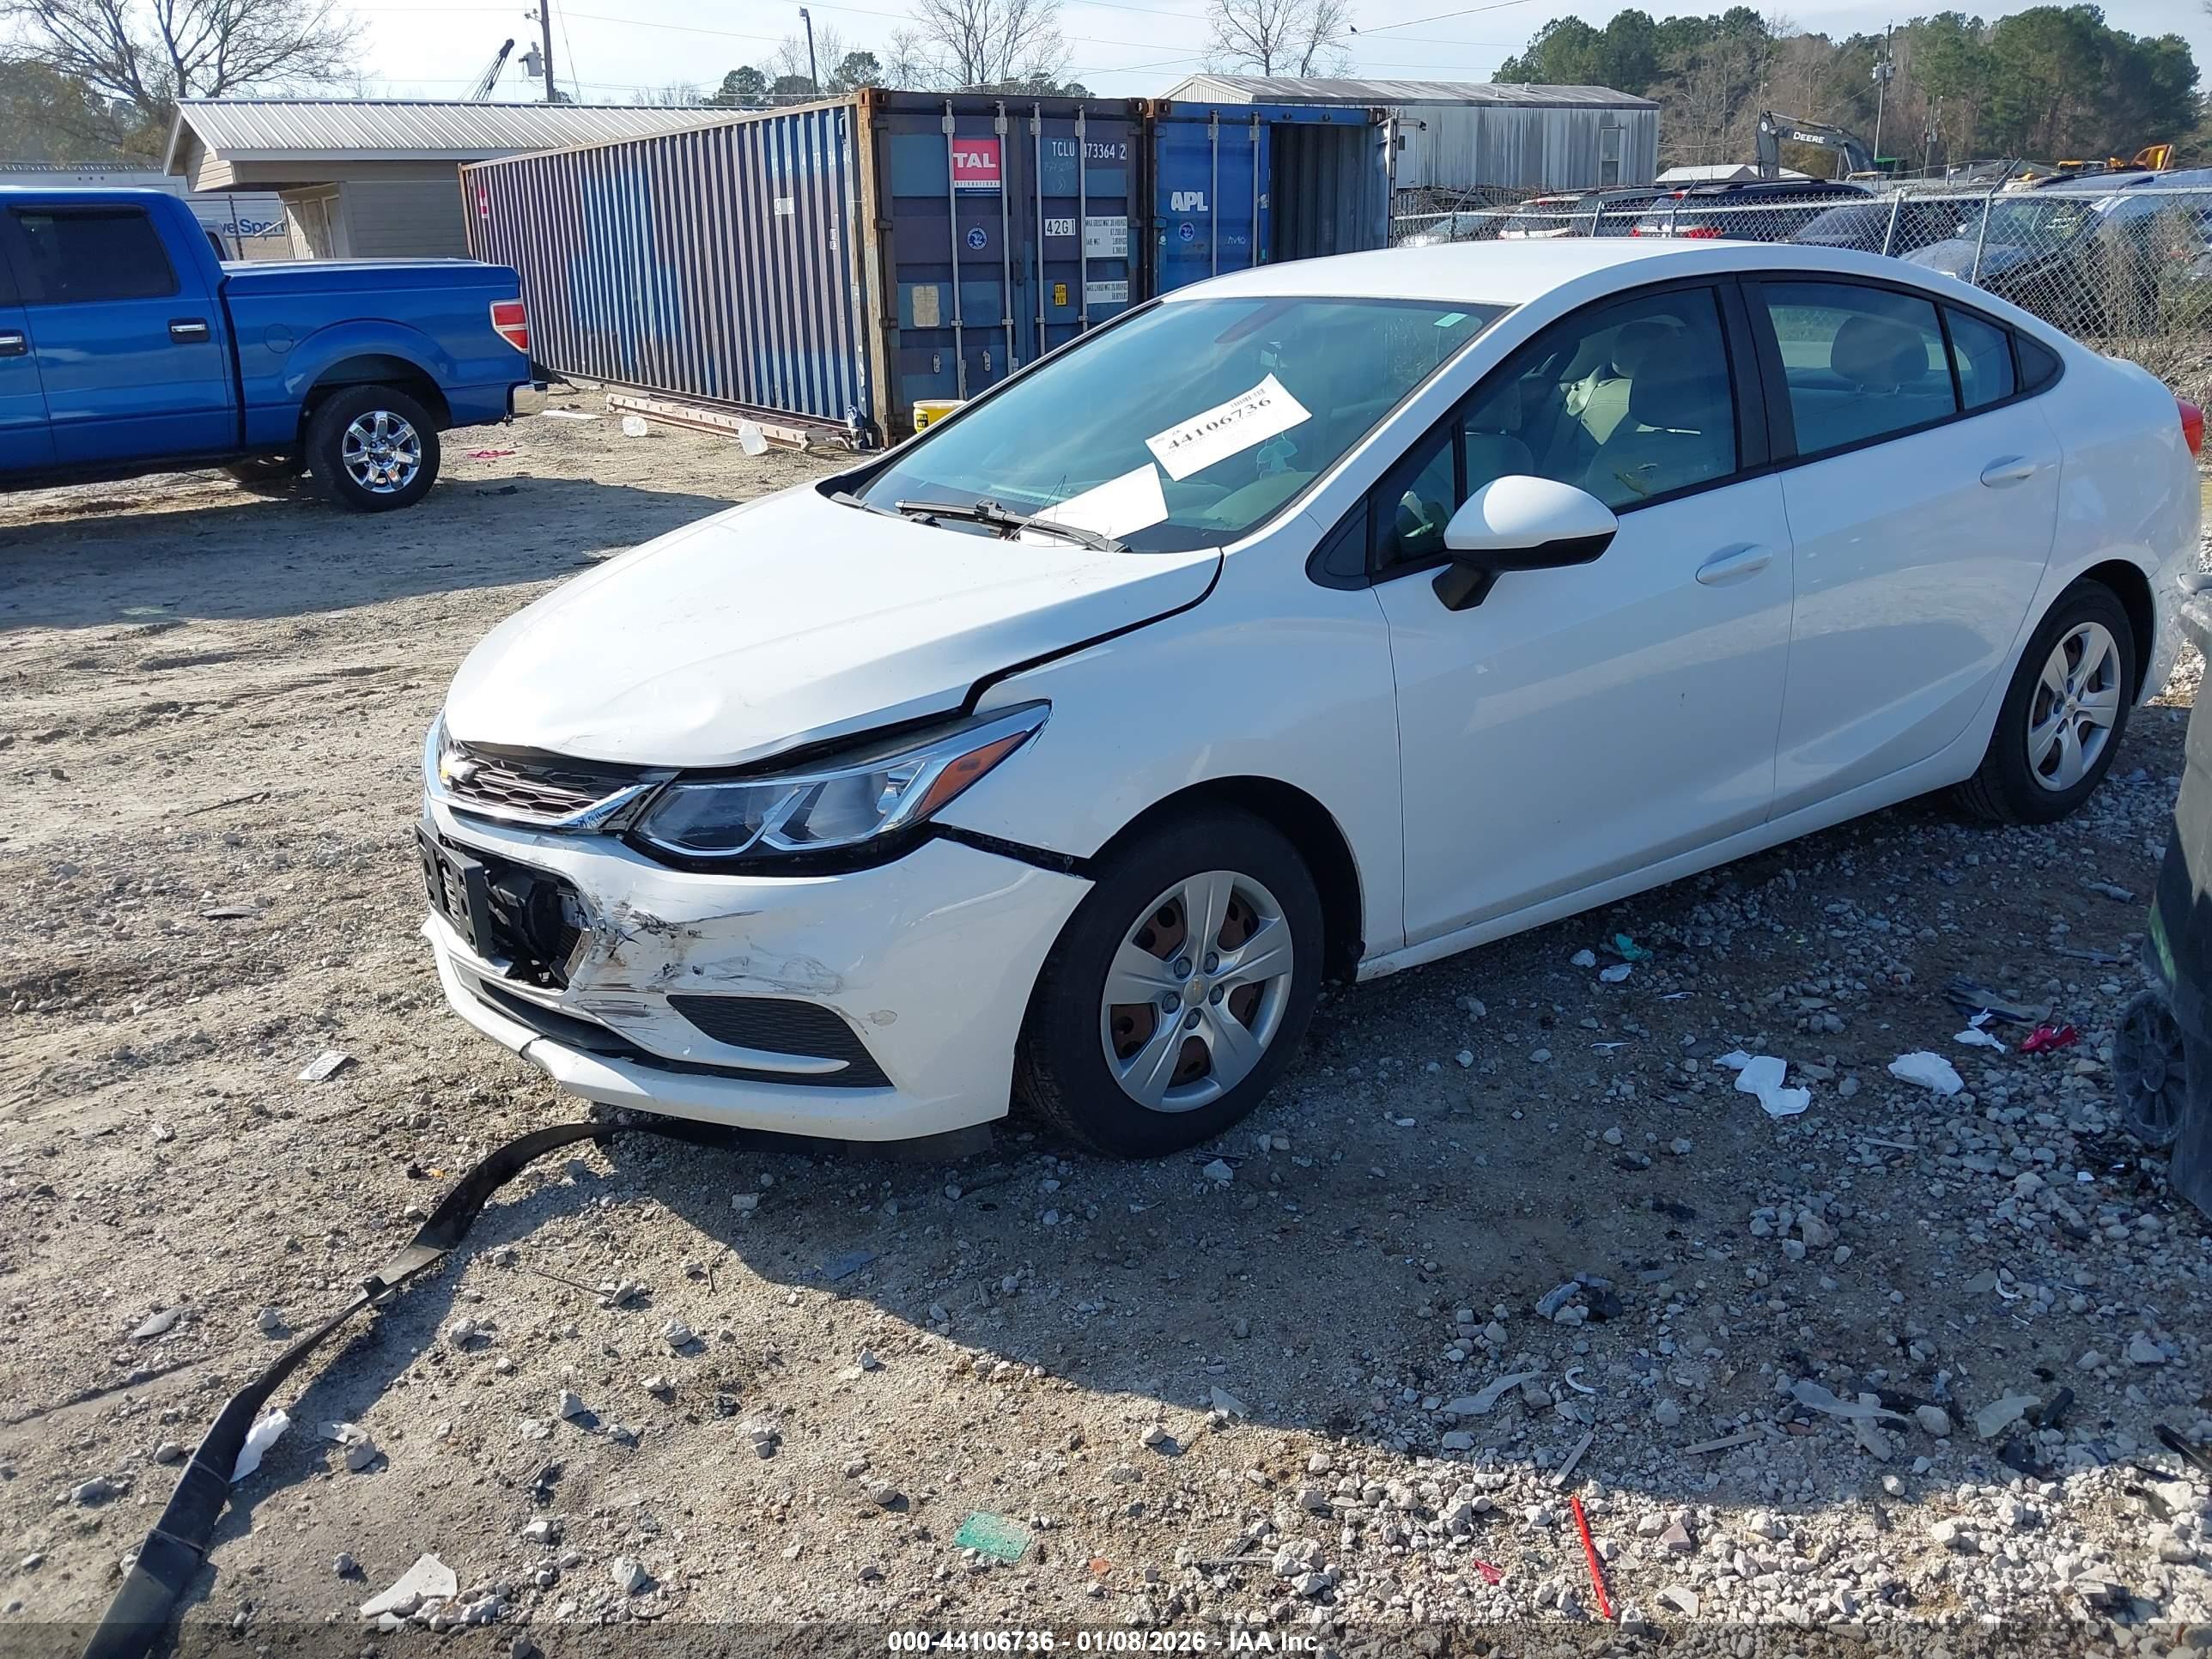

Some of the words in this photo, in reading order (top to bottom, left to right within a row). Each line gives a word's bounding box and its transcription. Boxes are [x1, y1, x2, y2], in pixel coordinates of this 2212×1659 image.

[1793, 131, 1826, 144] DEERE
[1052, 142, 1075, 156] TCLU
[953, 153, 997, 168] TAL
[1170, 191, 1208, 211] APL
[1047, 220, 1075, 234] 42G1
[1168, 398, 1272, 449] 44106736
